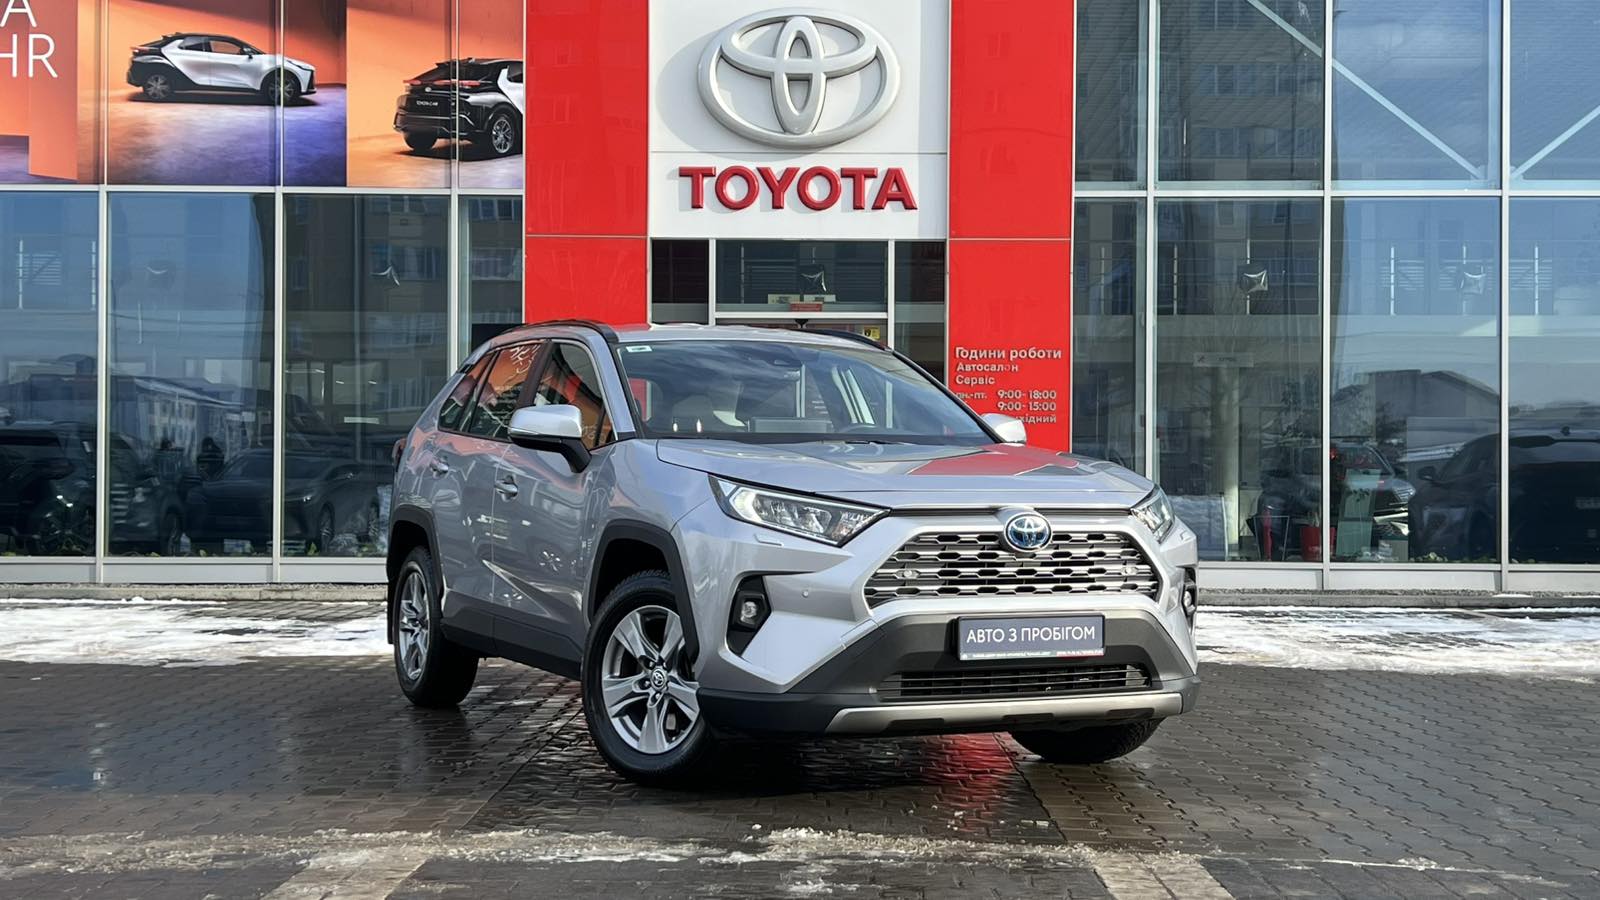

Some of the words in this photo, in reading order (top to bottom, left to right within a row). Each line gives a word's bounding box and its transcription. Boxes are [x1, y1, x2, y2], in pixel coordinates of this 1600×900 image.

[678, 165, 918, 211] TOYOTA
[955, 347, 1005, 360] Години
[1009, 347, 1062, 361] роботи
[956, 362, 1019, 372] Автосалон
[955, 376, 996, 387] Сервіс
[1015, 413, 1057, 424] хідний
[966, 629, 1005, 644] АВТО
[1021, 626, 1096, 641] ПРОБІГОМ
